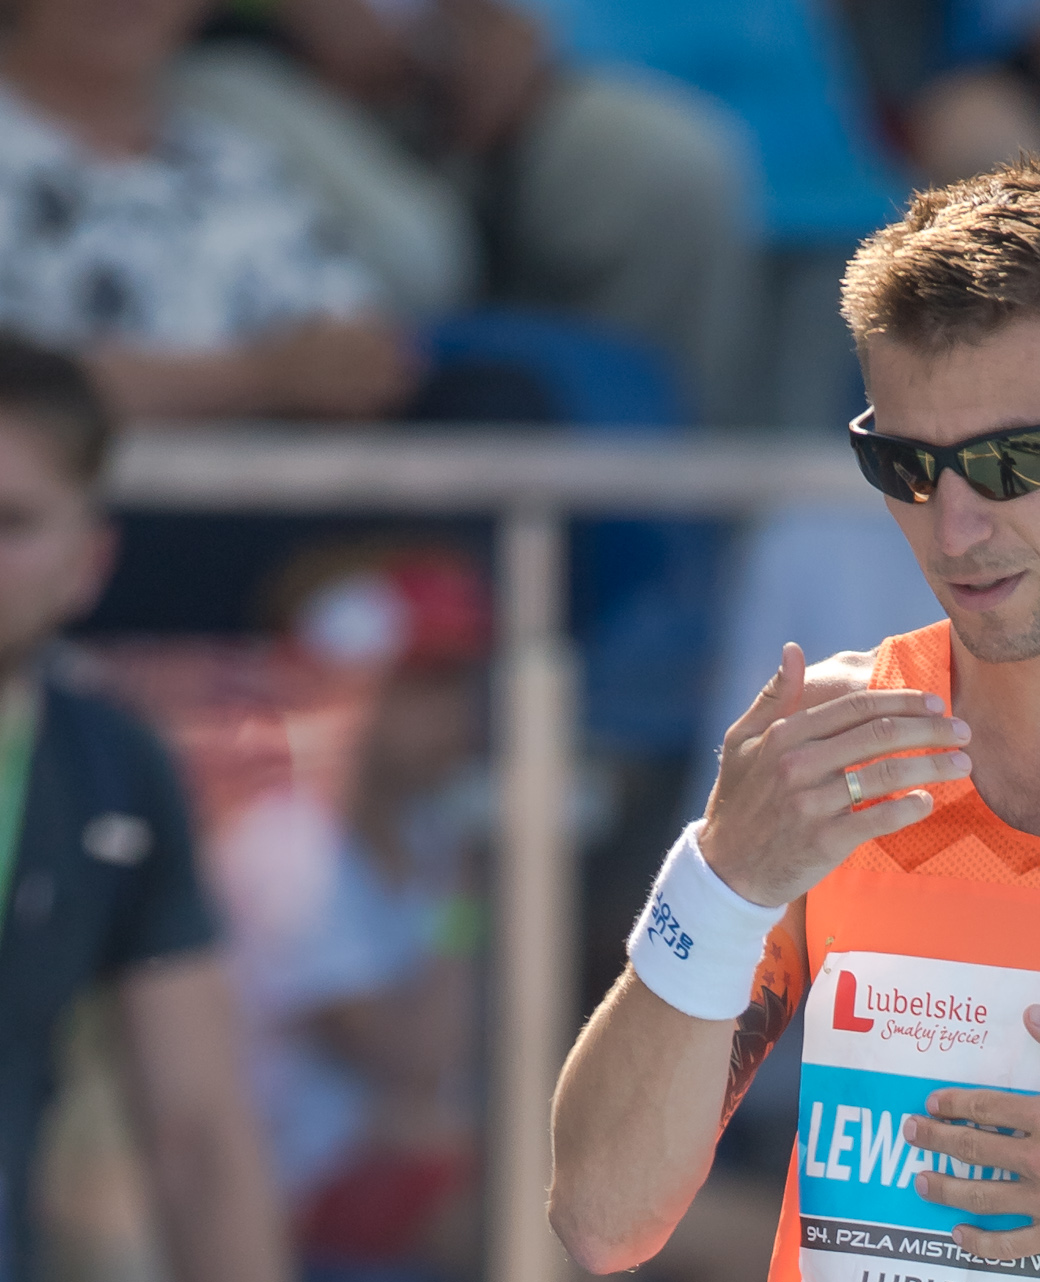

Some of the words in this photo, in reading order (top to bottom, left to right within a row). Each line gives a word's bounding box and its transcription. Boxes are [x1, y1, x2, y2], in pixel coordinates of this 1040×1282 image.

[880, 1019, 940, 1053] Smakuj
[806, 1225, 831, 1245] 94.
[836, 1228, 894, 1252] PZLA
